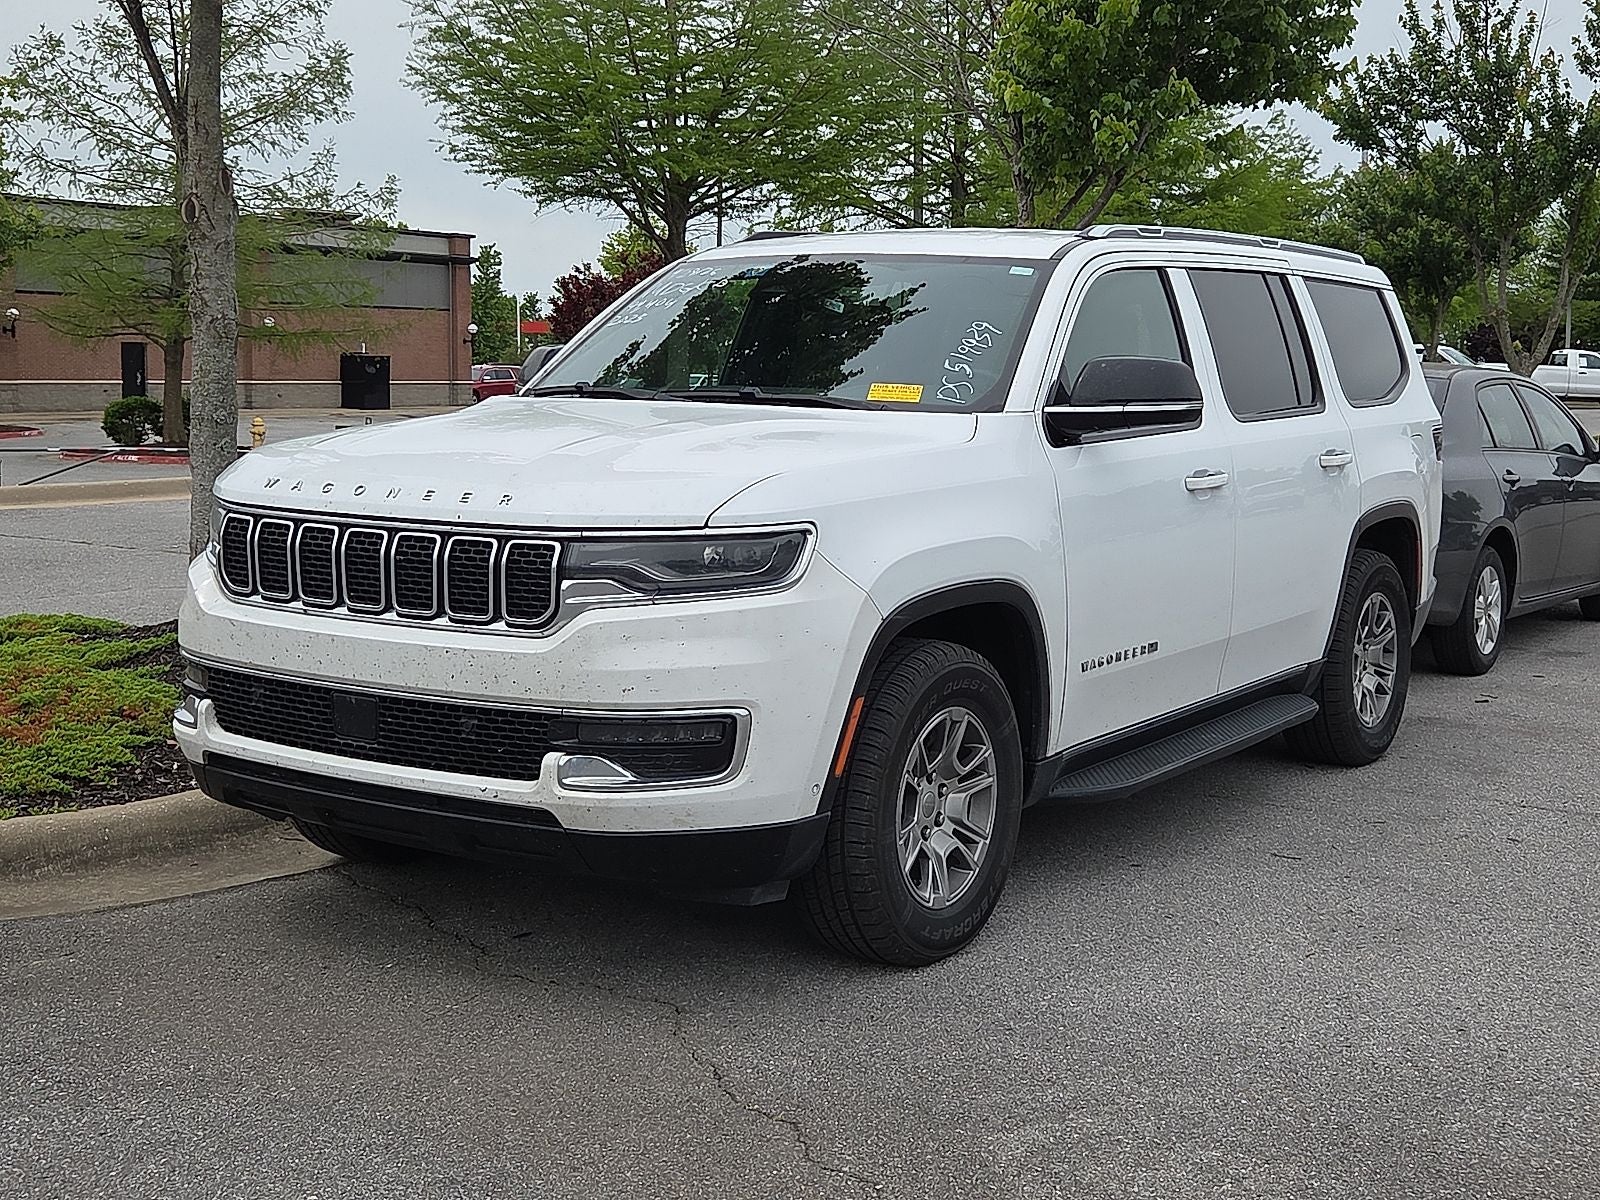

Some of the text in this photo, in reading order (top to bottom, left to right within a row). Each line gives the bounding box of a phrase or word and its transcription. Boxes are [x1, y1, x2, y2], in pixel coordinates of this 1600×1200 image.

[263, 477, 513, 506] WAGONEER
[1080, 645, 1147, 674] WAGONEER
[943, 679, 989, 696] QUEST
